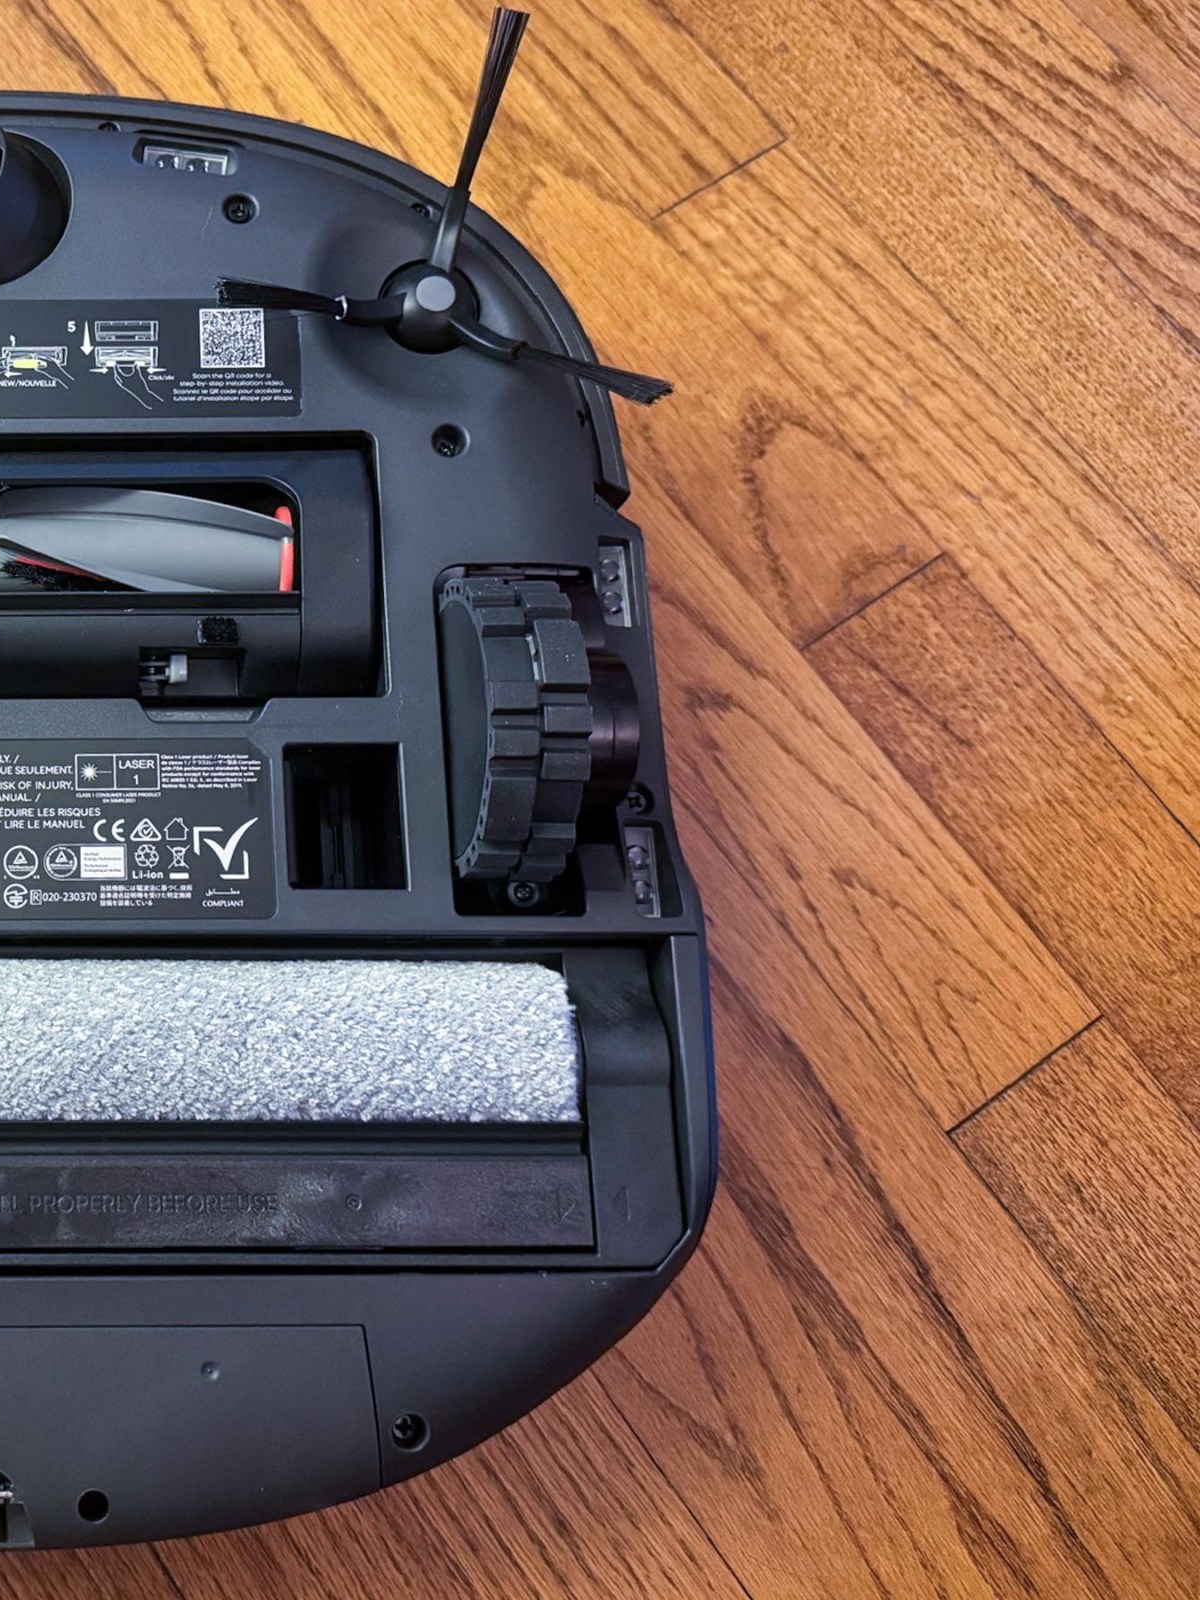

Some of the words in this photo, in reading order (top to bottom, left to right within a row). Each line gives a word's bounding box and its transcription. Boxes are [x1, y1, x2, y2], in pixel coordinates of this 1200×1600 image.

[67, 321, 76, 332] 5
[118, 760, 155, 769] LASER
[15, 766, 73, 774] SEULEMENT.
[132, 774, 139, 785] 1
[18, 781, 31, 790] OF
[35, 781, 74, 791] INJURY,
[37, 807, 55, 816] LES
[58, 807, 101, 816] RISQUES
[4, 820, 24, 829] LIRE
[28, 820, 40, 829] LE
[43, 820, 85, 829] MANUEL
[132, 870, 164, 879] Li-ion
[29, 1192, 142, 1215] PROPERLY
[148, 1192, 231, 1214] BEFORE
[237, 1192, 277, 1214] USE
